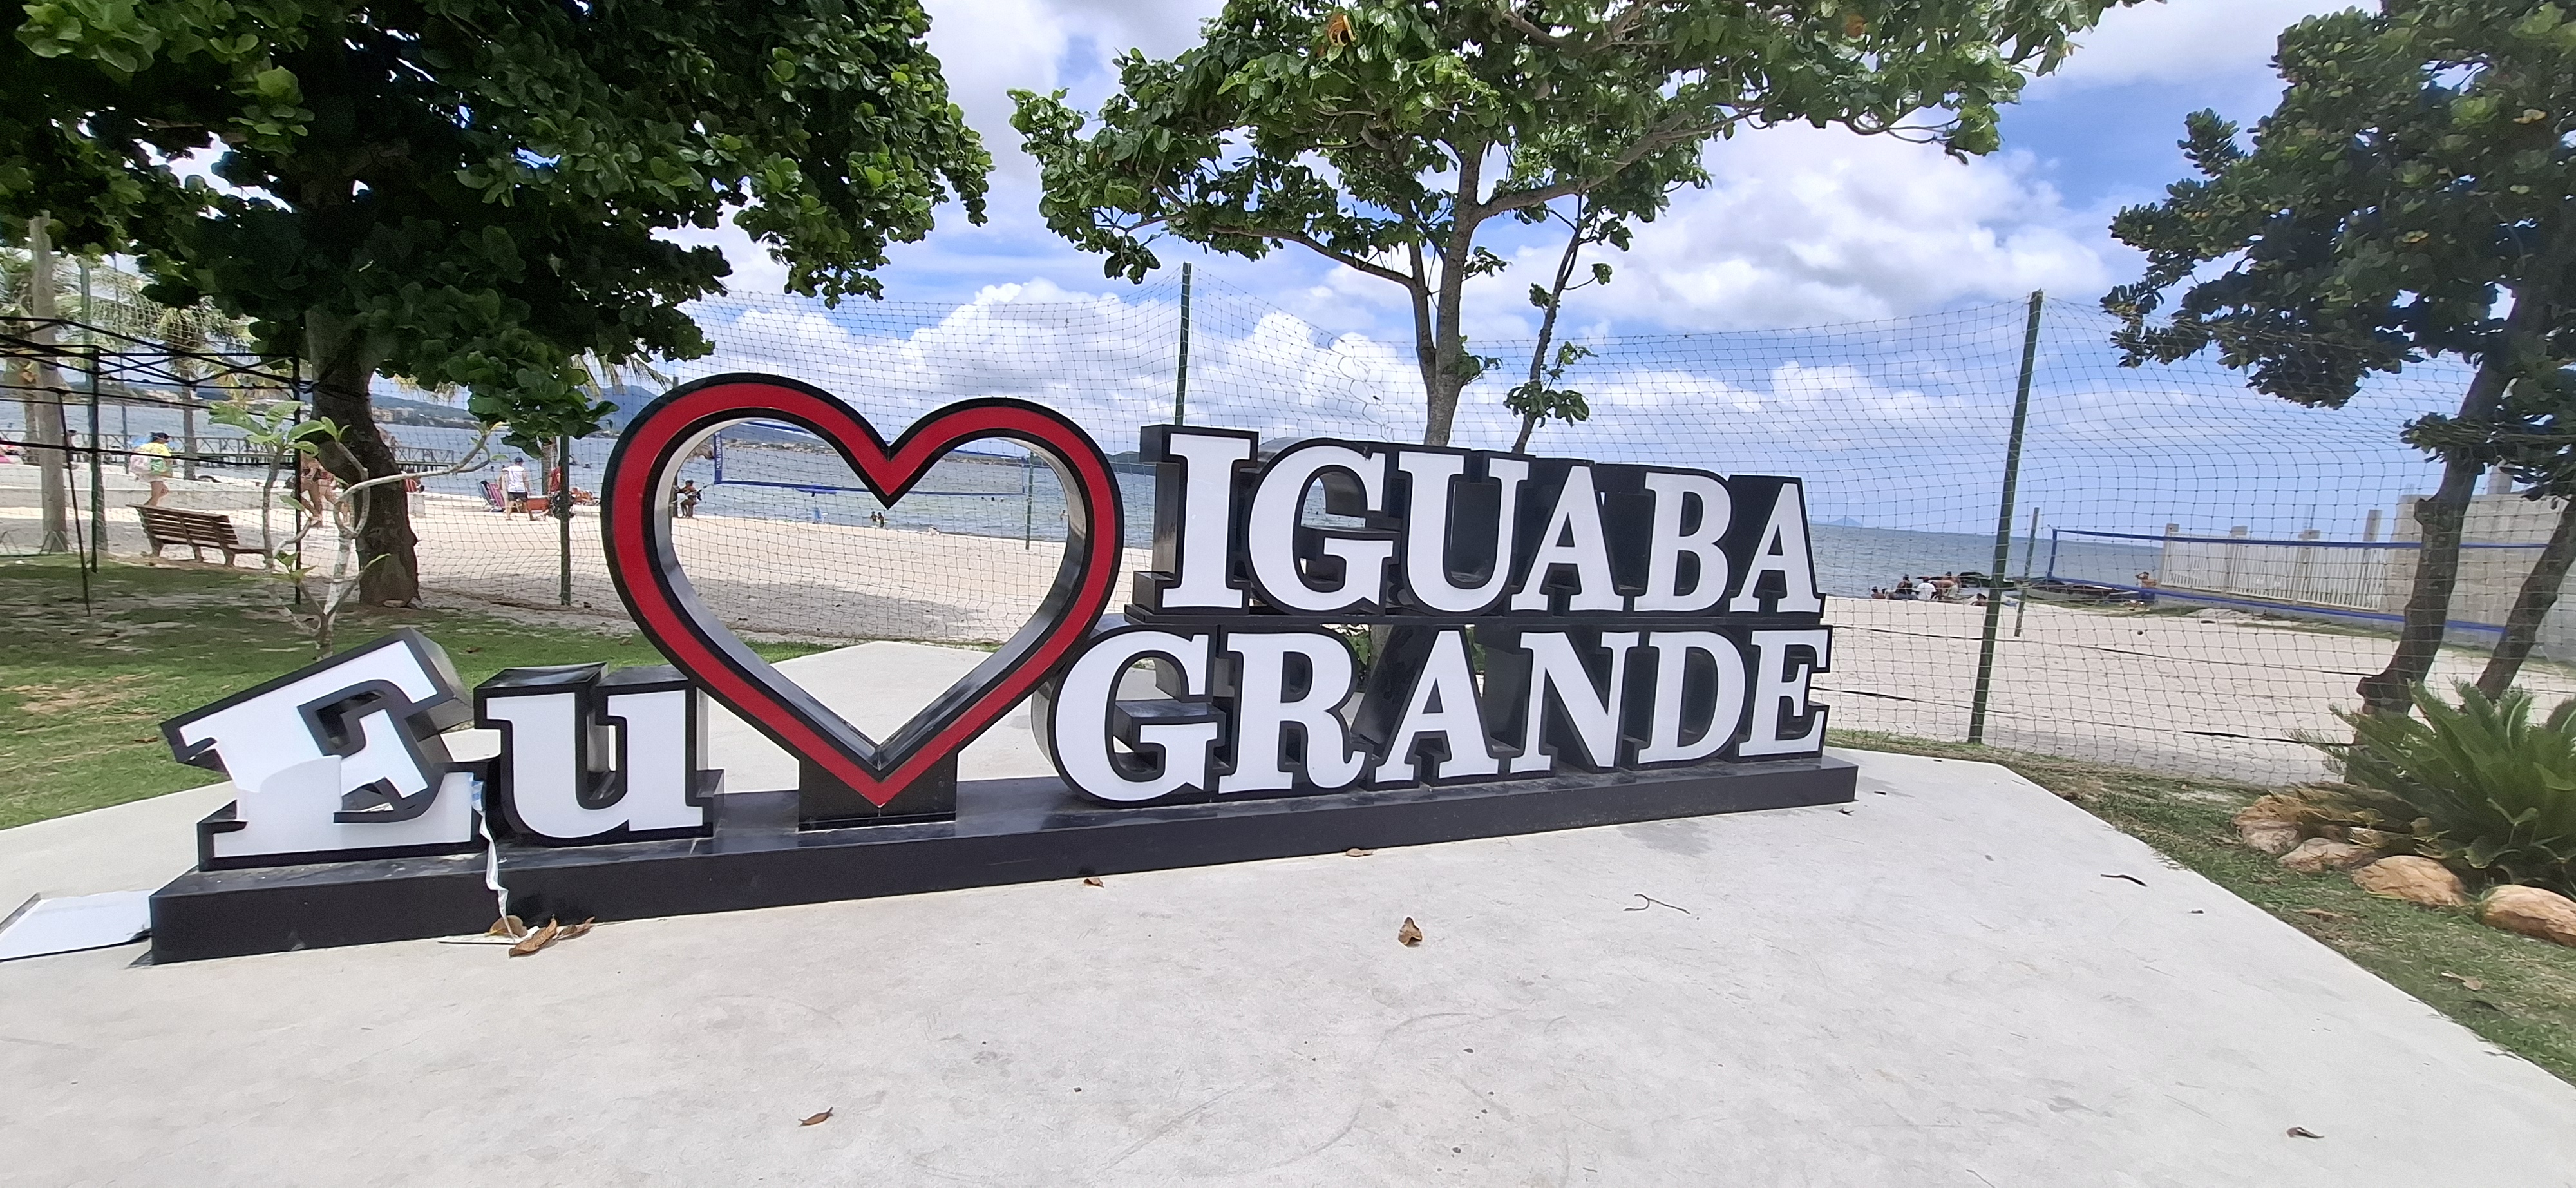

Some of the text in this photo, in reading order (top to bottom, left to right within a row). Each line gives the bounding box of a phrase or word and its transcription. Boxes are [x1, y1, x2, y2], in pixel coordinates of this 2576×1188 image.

[1161, 432, 1824, 615] IGUABA
[174, 637, 707, 861] Eu
[1054, 627, 1830, 803] GRANDE
